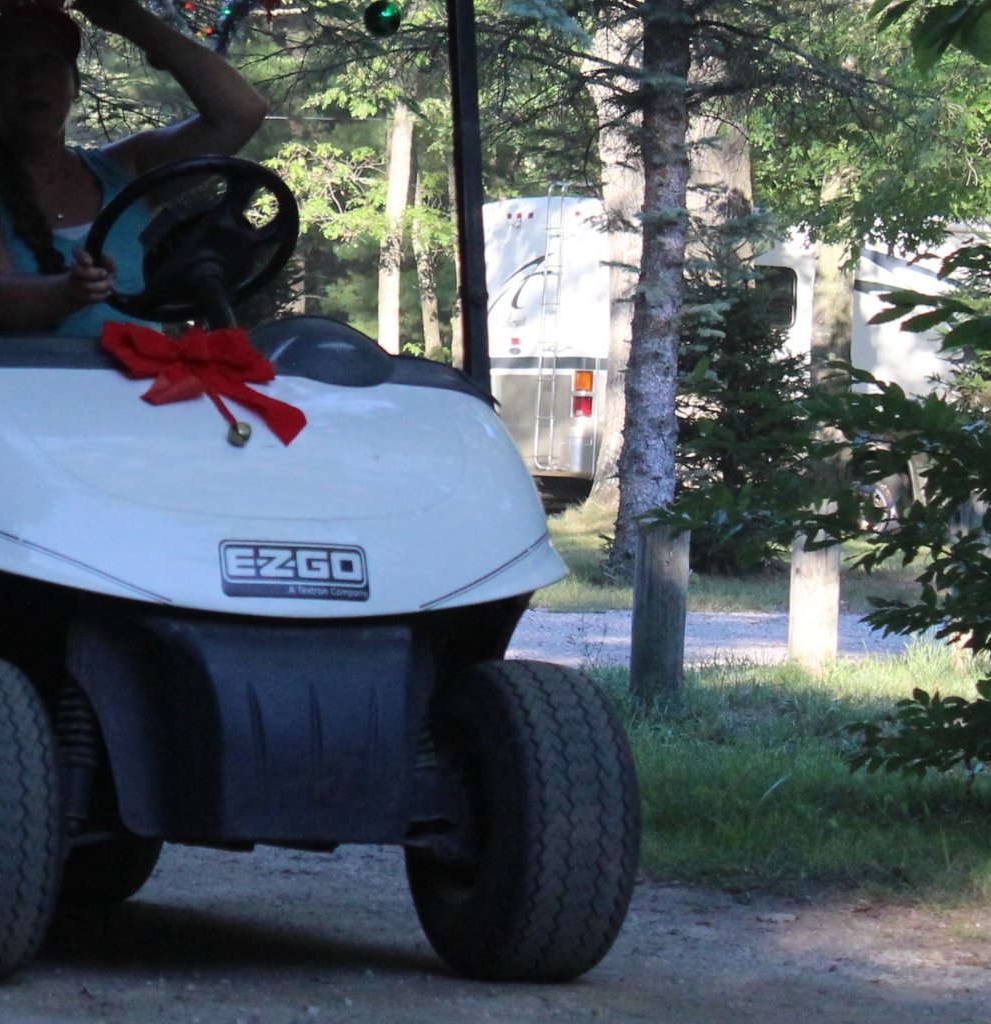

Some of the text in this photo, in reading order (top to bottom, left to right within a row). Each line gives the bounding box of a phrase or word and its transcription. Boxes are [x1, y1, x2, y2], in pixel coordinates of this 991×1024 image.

[225, 547, 365, 582] EZGO
[298, 586, 328, 596] Textron
[330, 587, 369, 598] Company
